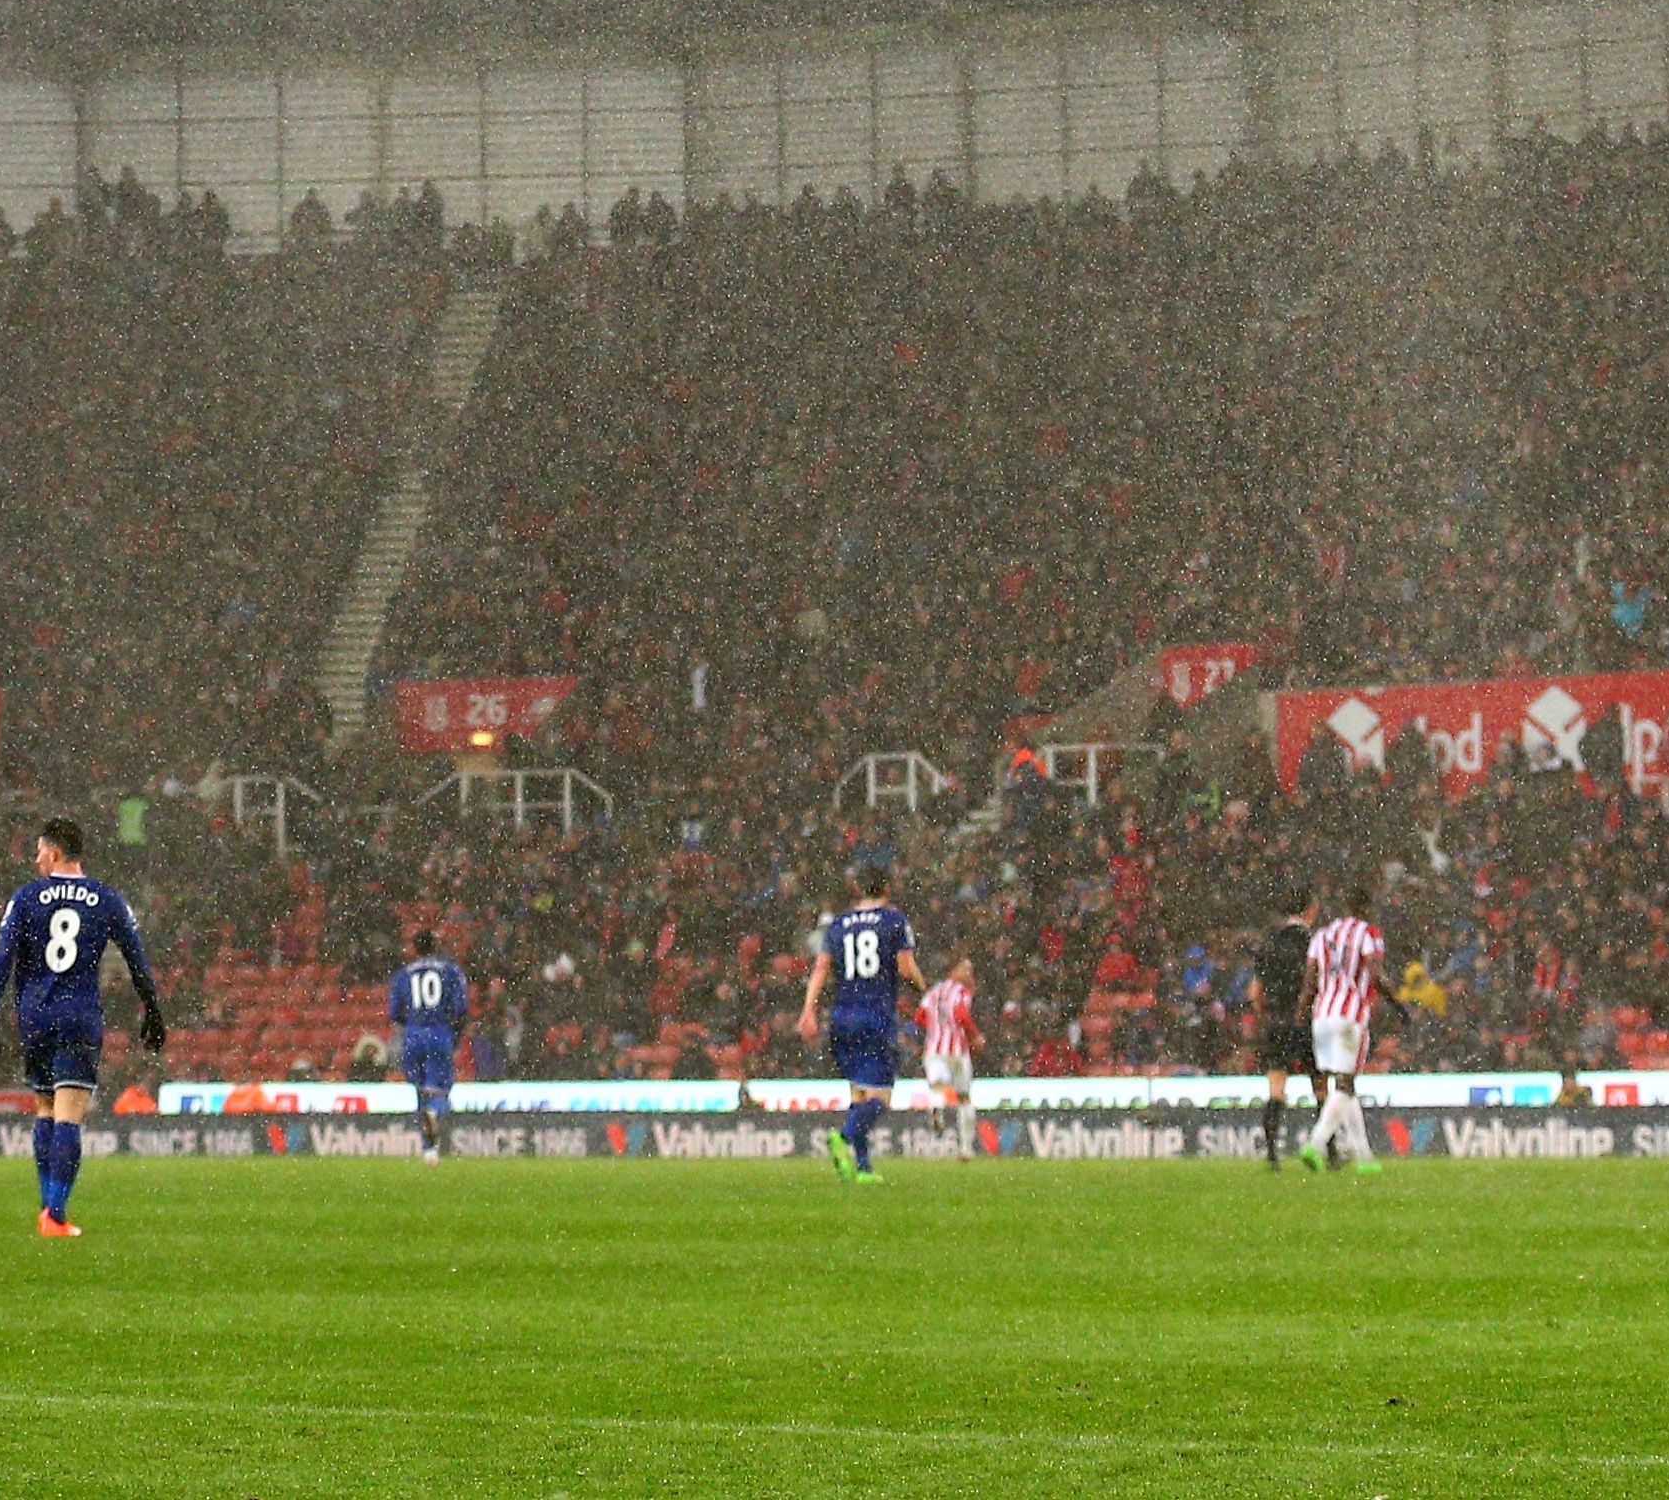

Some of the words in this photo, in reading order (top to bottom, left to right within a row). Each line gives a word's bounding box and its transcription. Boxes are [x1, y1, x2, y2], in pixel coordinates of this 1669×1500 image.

[467, 694, 509, 727] 26
[39, 884, 99, 907] OVIEDO
[45, 907, 81, 973] 8
[843, 930, 881, 981] 18
[411, 969, 443, 1010] 10
[1442, 1116, 1615, 1158] Valvoline
